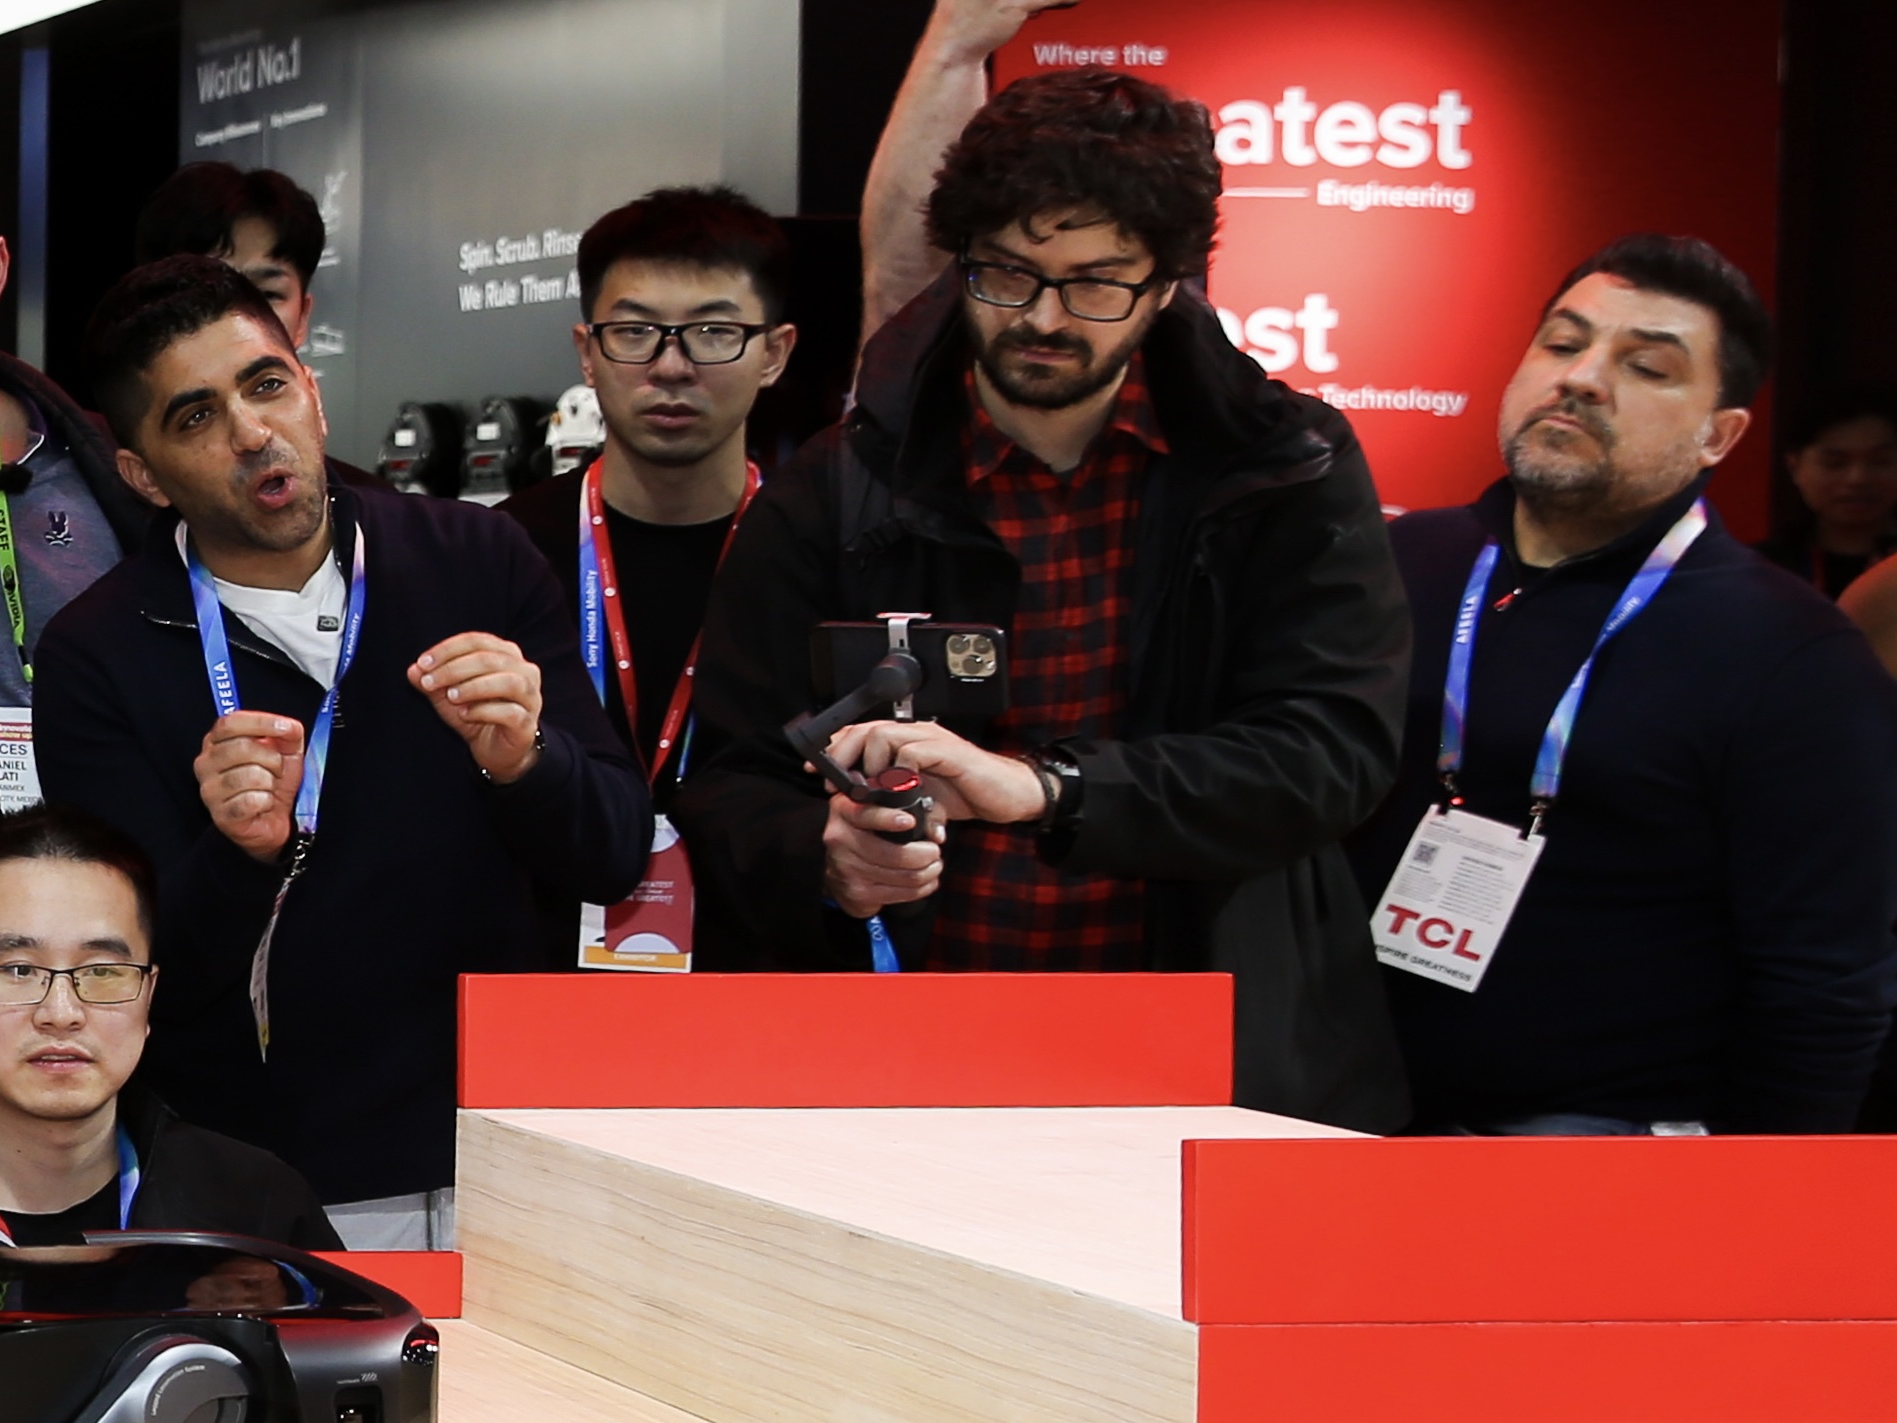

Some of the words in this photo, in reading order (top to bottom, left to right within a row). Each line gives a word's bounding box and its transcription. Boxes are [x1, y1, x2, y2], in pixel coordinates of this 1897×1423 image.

[197, 51, 253, 104] World
[257, 36, 301, 88] No.1
[1033, 44, 1117, 66] Where
[1122, 44, 1167, 66] the
[1215, 85, 1473, 170] atest
[1316, 179, 1476, 214] Engineering
[458, 240, 494, 276] Spin.
[495, 233, 539, 266] Scrub.
[458, 281, 483, 312] We
[484, 279, 518, 310] Rule
[520, 273, 564, 304] Them
[1318, 383, 1469, 417] Technology
[585, 569, 598, 610] Mobility
[586, 611, 598, 646] Honda
[586, 648, 598, 669] Sony
[0, 743, 28, 756] CES
[1385, 903, 1482, 962] TCL
